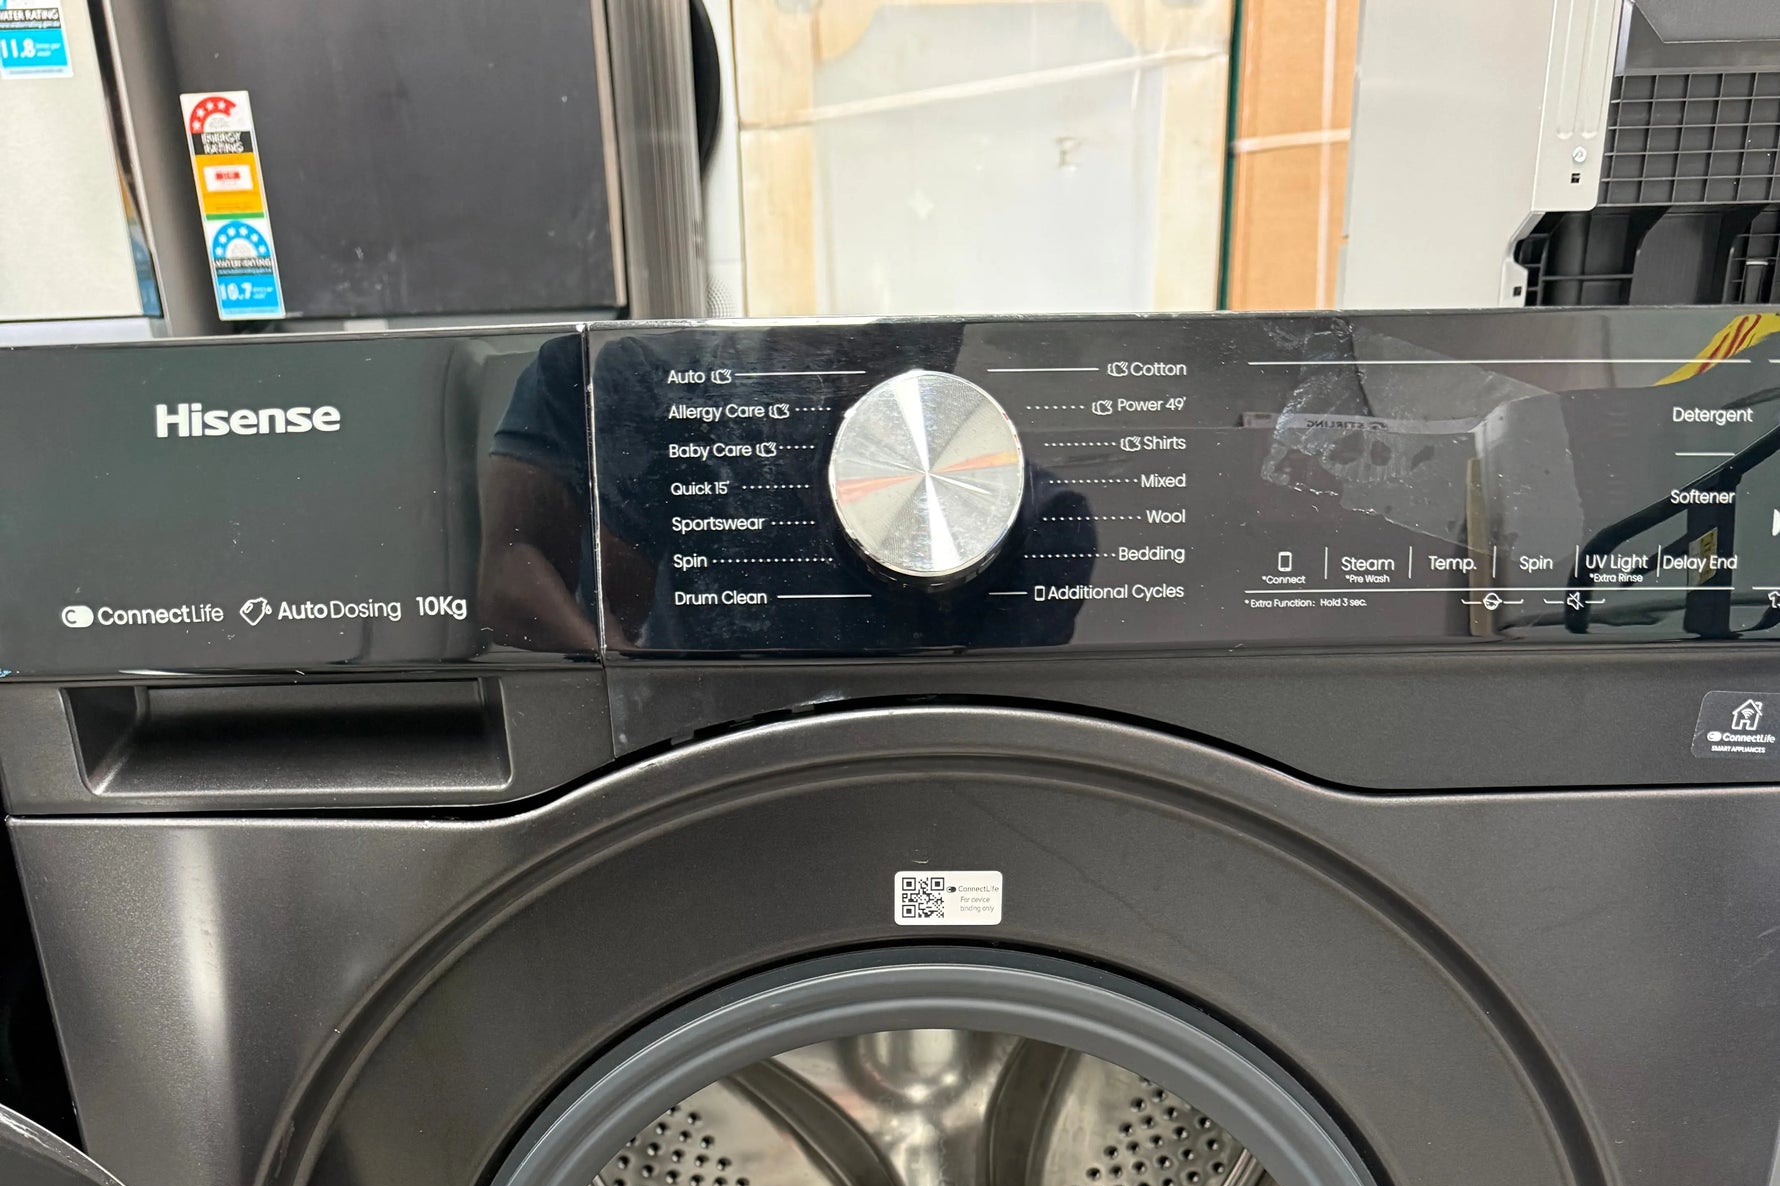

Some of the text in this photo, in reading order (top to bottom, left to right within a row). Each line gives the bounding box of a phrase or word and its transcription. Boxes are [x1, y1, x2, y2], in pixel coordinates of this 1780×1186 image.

[1, 38, 36, 58] 11.8
[667, 369, 706, 384] Auto
[1130, 362, 1187, 376] Cotton
[668, 403, 765, 421] Allergy Care
[1117, 398, 1163, 412] Power
[155, 402, 341, 438] Hisense
[1672, 407, 1753, 425] Detergent
[1143, 436, 1187, 450] Shirts
[668, 443, 752, 460] Baby Care
[1141, 473, 1187, 488] Mixed
[670, 482, 712, 496] Quick
[1670, 490, 1735, 504] Softener
[671, 515, 765, 534] Sportswear
[1146, 509, 1186, 524] Wool
[673, 553, 708, 571] Spin
[1118, 546, 1186, 563] Bedding
[1341, 556, 1395, 572] Steam
[1428, 555, 1477, 573] Temp.
[1519, 555, 1553, 573] Spin
[1585, 554, 1649, 572] UV Light
[1662, 554, 1738, 572] Delay End
[1364, 573, 1390, 584] Wash
[1618, 573, 1643, 582] Rinse
[674, 590, 768, 606] Drum Clean
[1048, 584, 1185, 602] Additional Cycles
[416, 595, 467, 620] 10Kg
[1274, 598, 1316, 608] Function:
[1320, 598, 1341, 607] Hold
[1342, 597, 1349, 607] 3
[1349, 599, 1367, 607] sec.
[1722, 732, 1776, 744] ConnectLife
